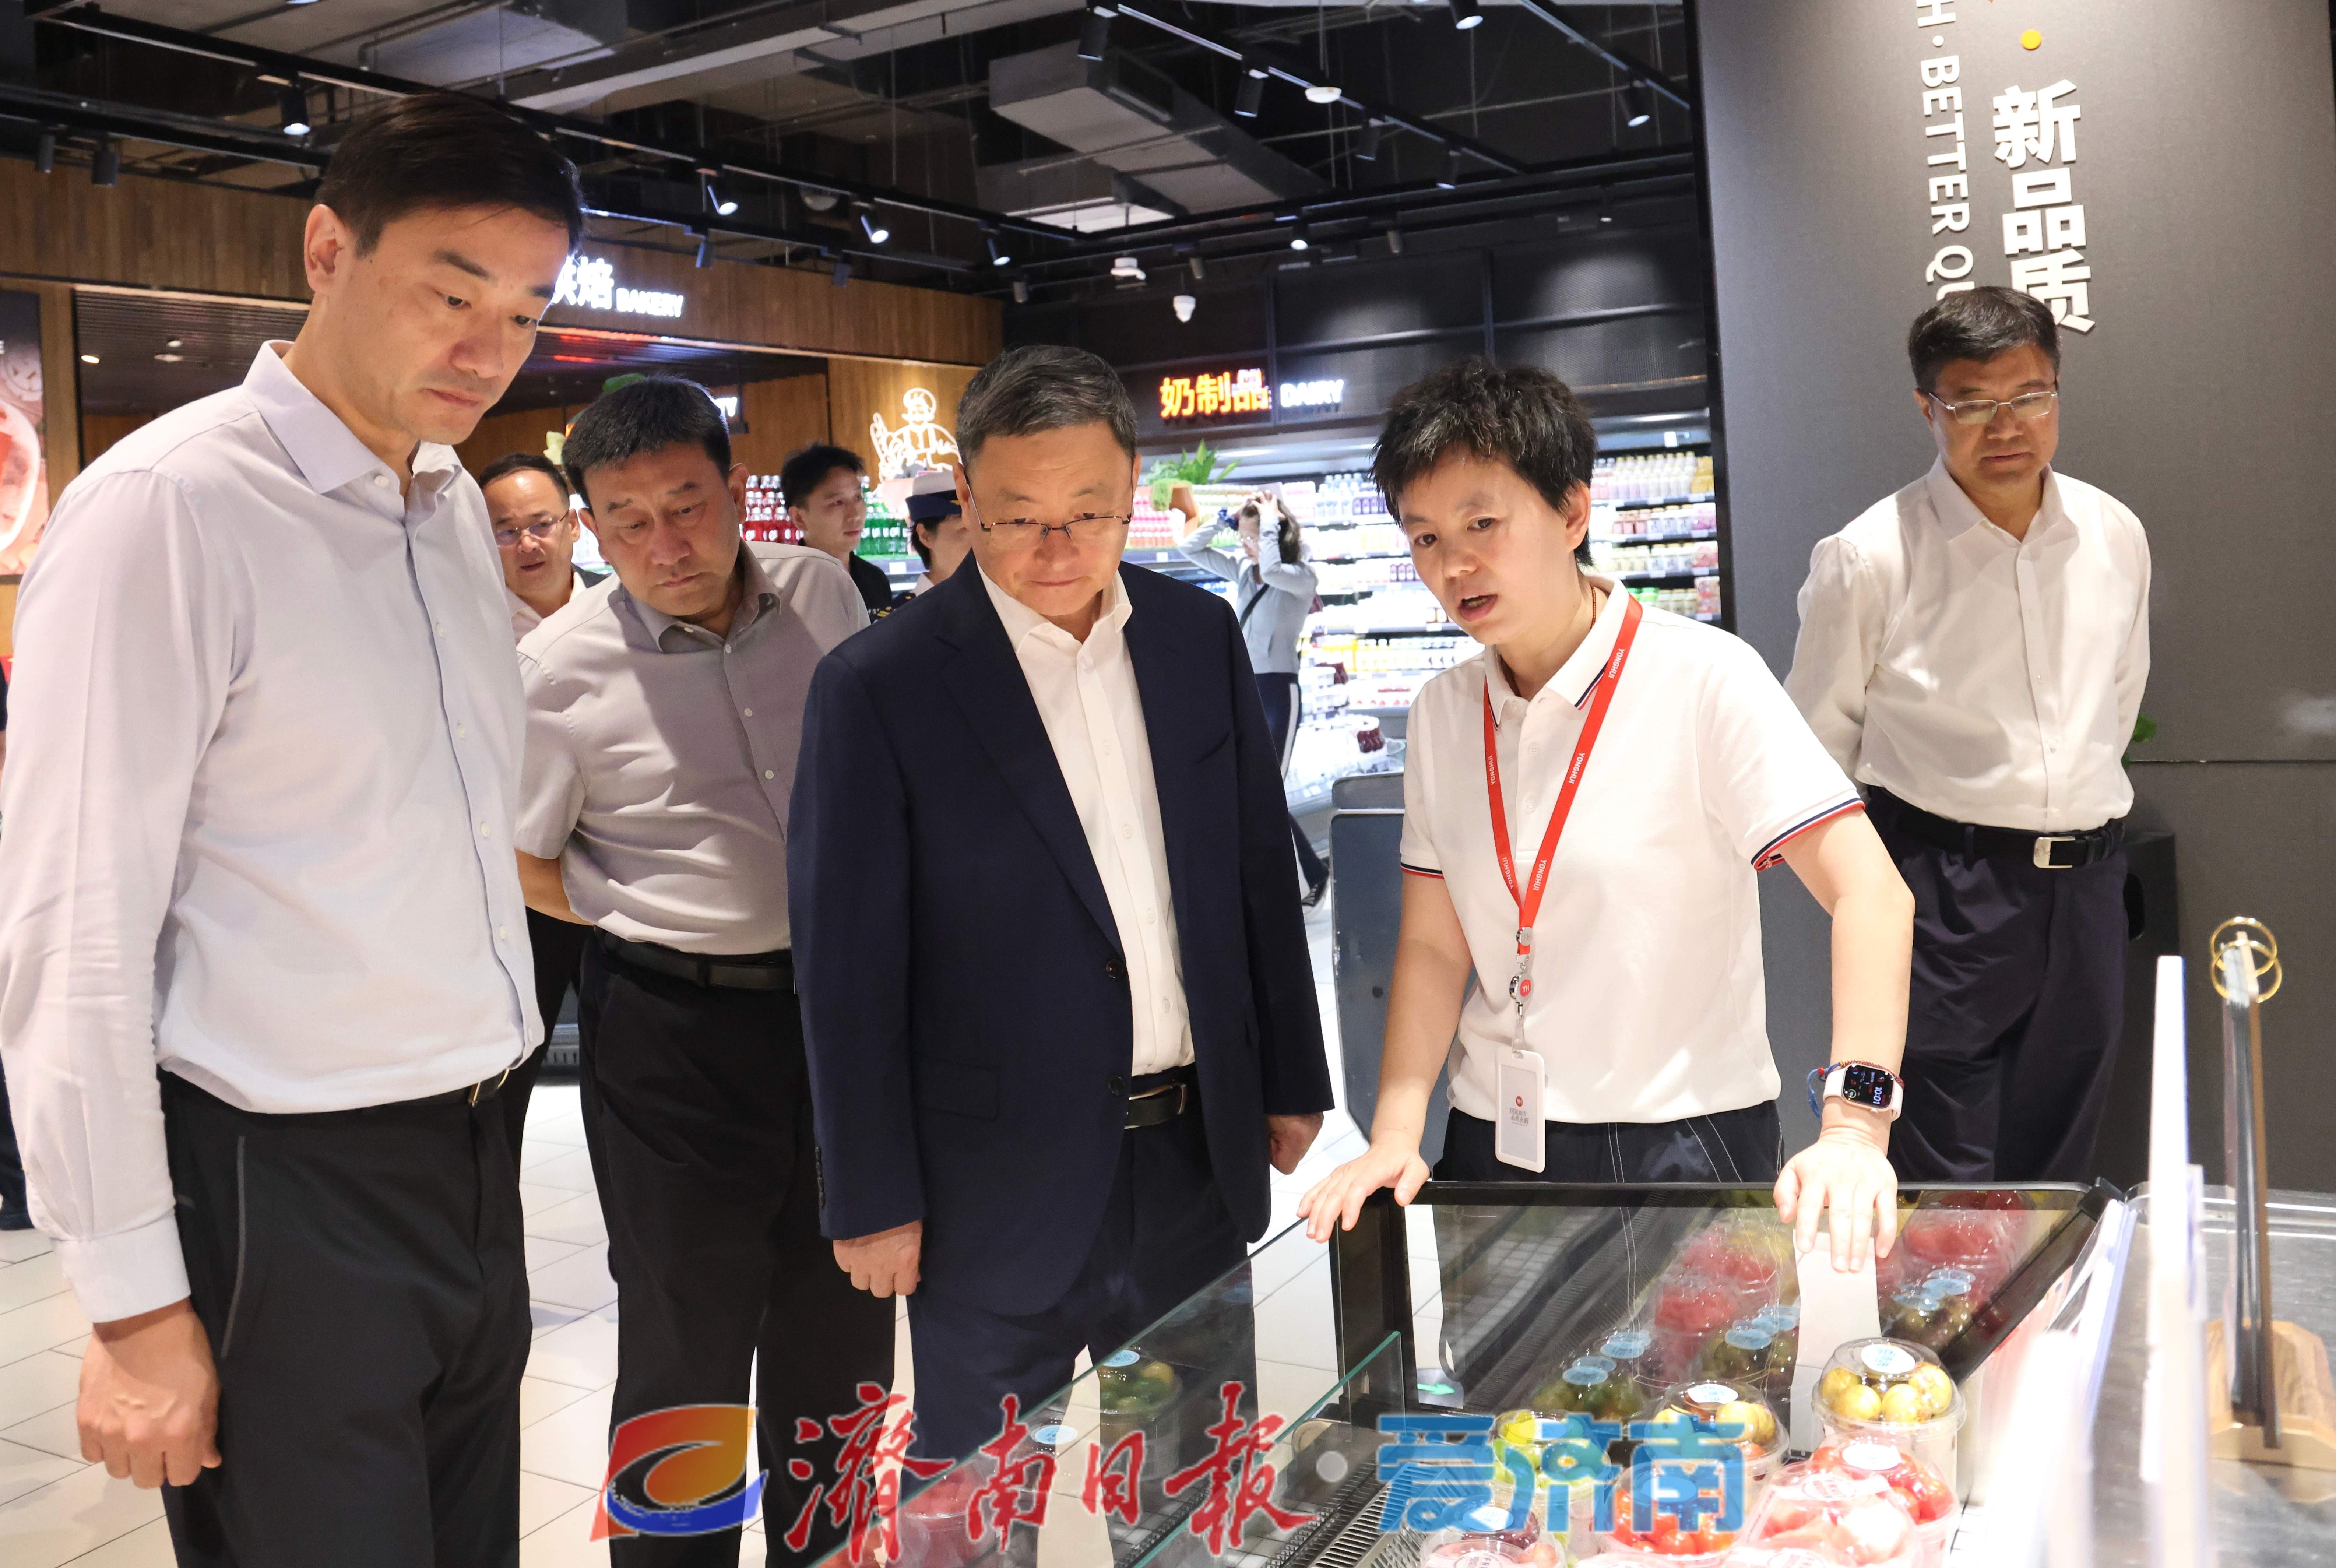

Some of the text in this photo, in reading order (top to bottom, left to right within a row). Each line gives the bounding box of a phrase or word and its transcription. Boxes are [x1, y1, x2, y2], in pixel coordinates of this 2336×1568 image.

[1993, 79, 2095, 333] 新品质
[616, 288, 684, 318] BAKERY
[1160, 368, 1344, 419] 奶制品 DAIRY
[1608, 648, 1625, 679] YONGHUI
[1488, 755, 1496, 785] YONGHUI
[1568, 753, 1585, 784] YONGHUI
[1502, 857, 1514, 889] YONGHUI
[1533, 859, 1547, 891] YONGHUI
[1522, 984, 1529, 993] YH
[1873, 1087, 1882, 1105] 10:01
